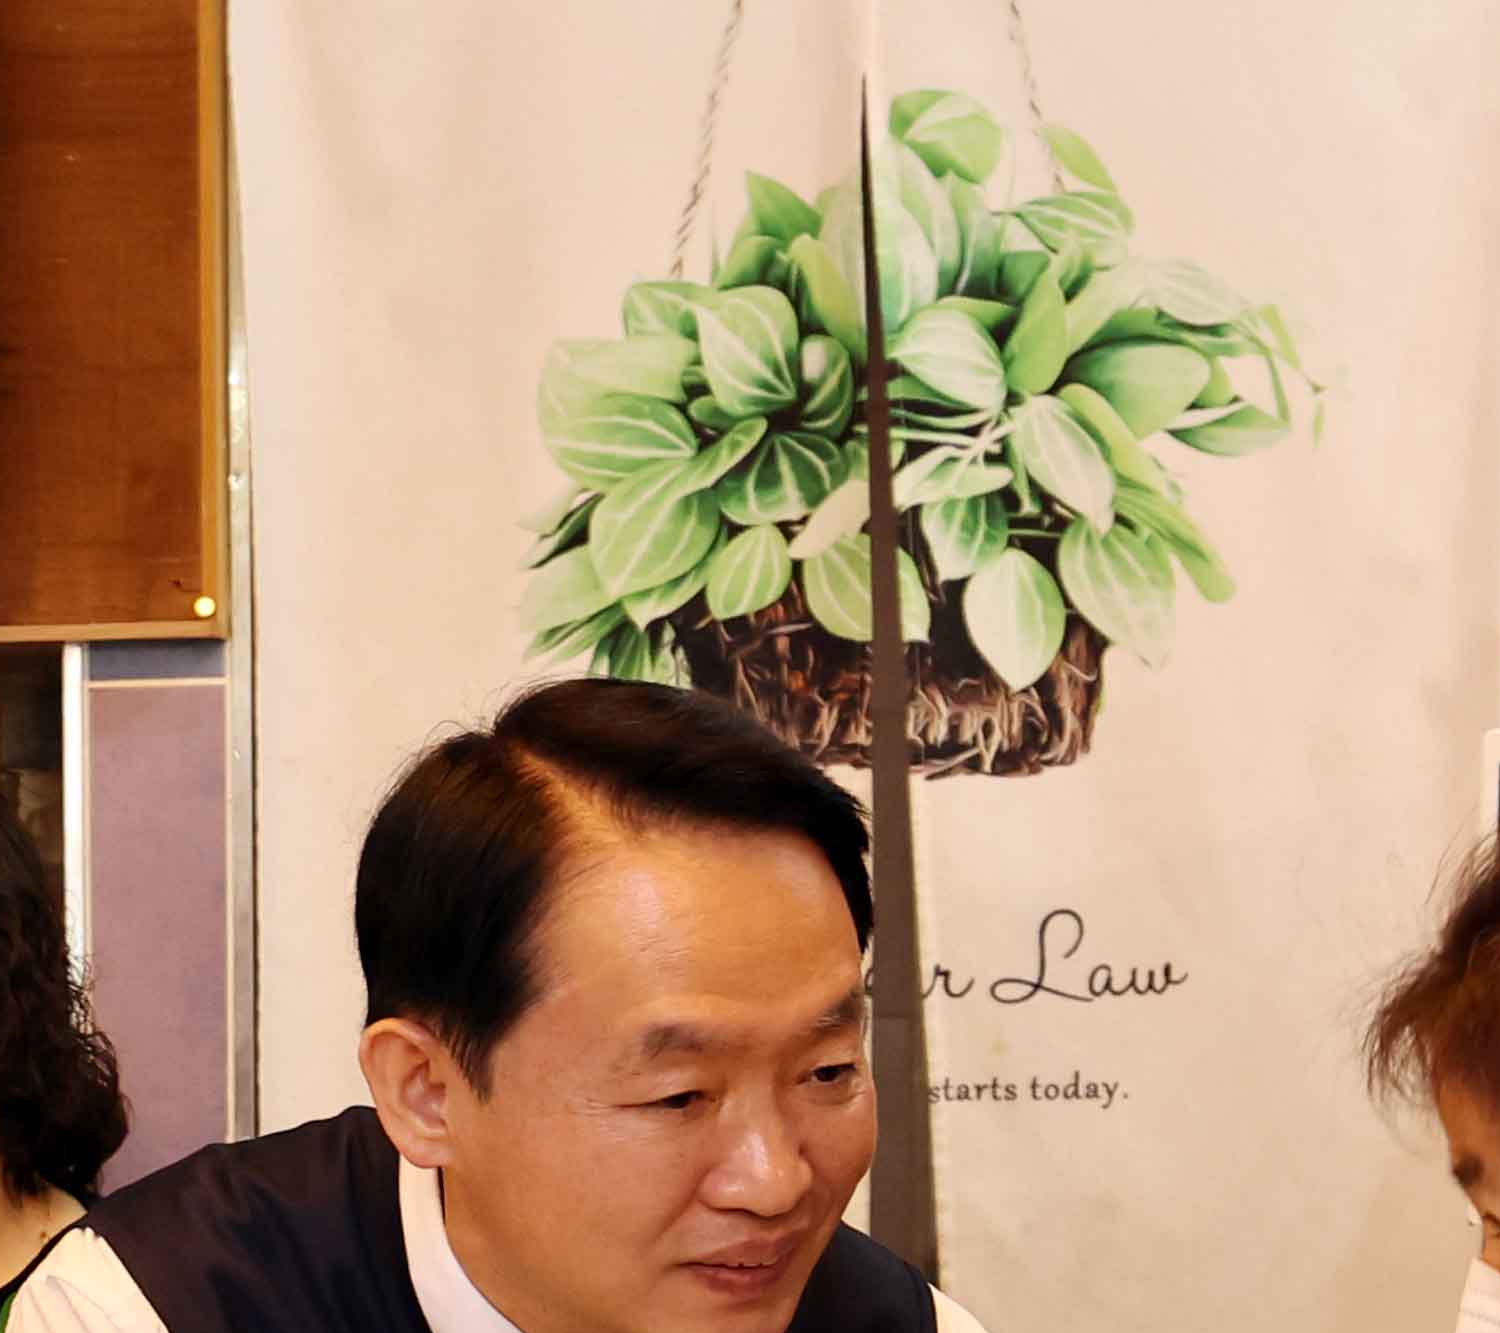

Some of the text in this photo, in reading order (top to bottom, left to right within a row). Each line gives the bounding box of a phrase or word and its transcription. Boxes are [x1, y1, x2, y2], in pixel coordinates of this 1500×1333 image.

[990, 908, 1188, 1004] Law
[928, 1070, 1129, 1109] starts today.
